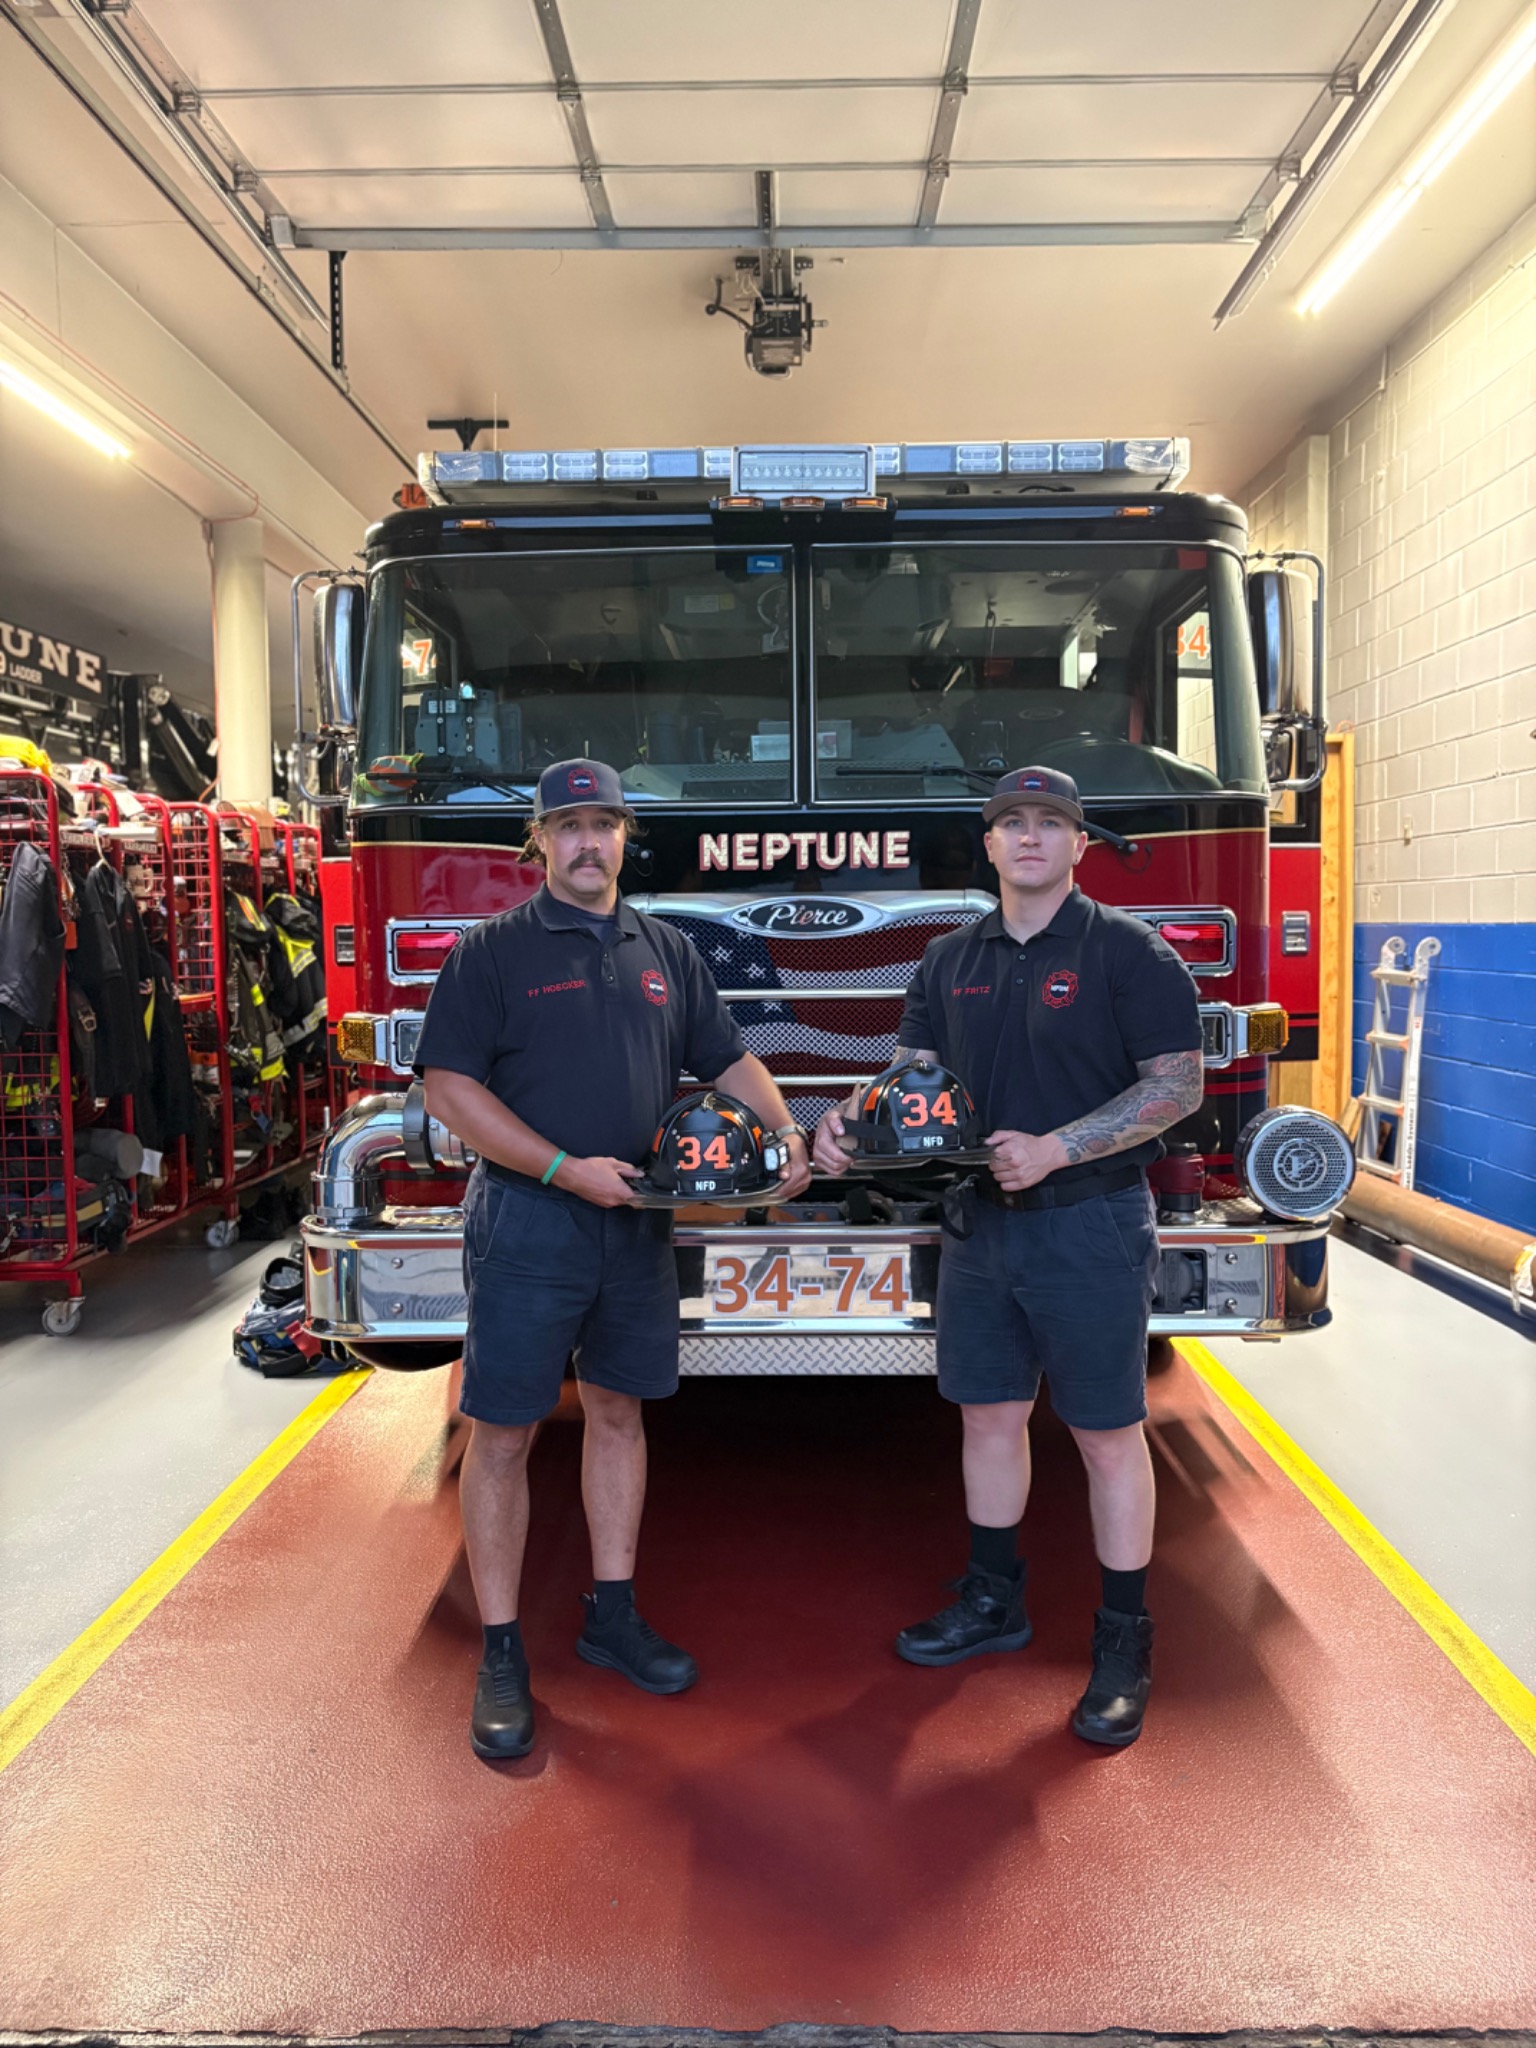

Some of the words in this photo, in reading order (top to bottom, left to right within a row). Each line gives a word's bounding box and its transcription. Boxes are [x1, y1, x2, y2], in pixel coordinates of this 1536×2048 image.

[700, 831, 910, 870] NEPTUNE
[765, 903, 849, 929] Pierce
[901, 1090, 956, 1127] 34
[677, 1135, 731, 1171] 34
[923, 1136, 944, 1148] NFD
[695, 1181, 717, 1191] NFD
[713, 1254, 912, 1315] 34-74
